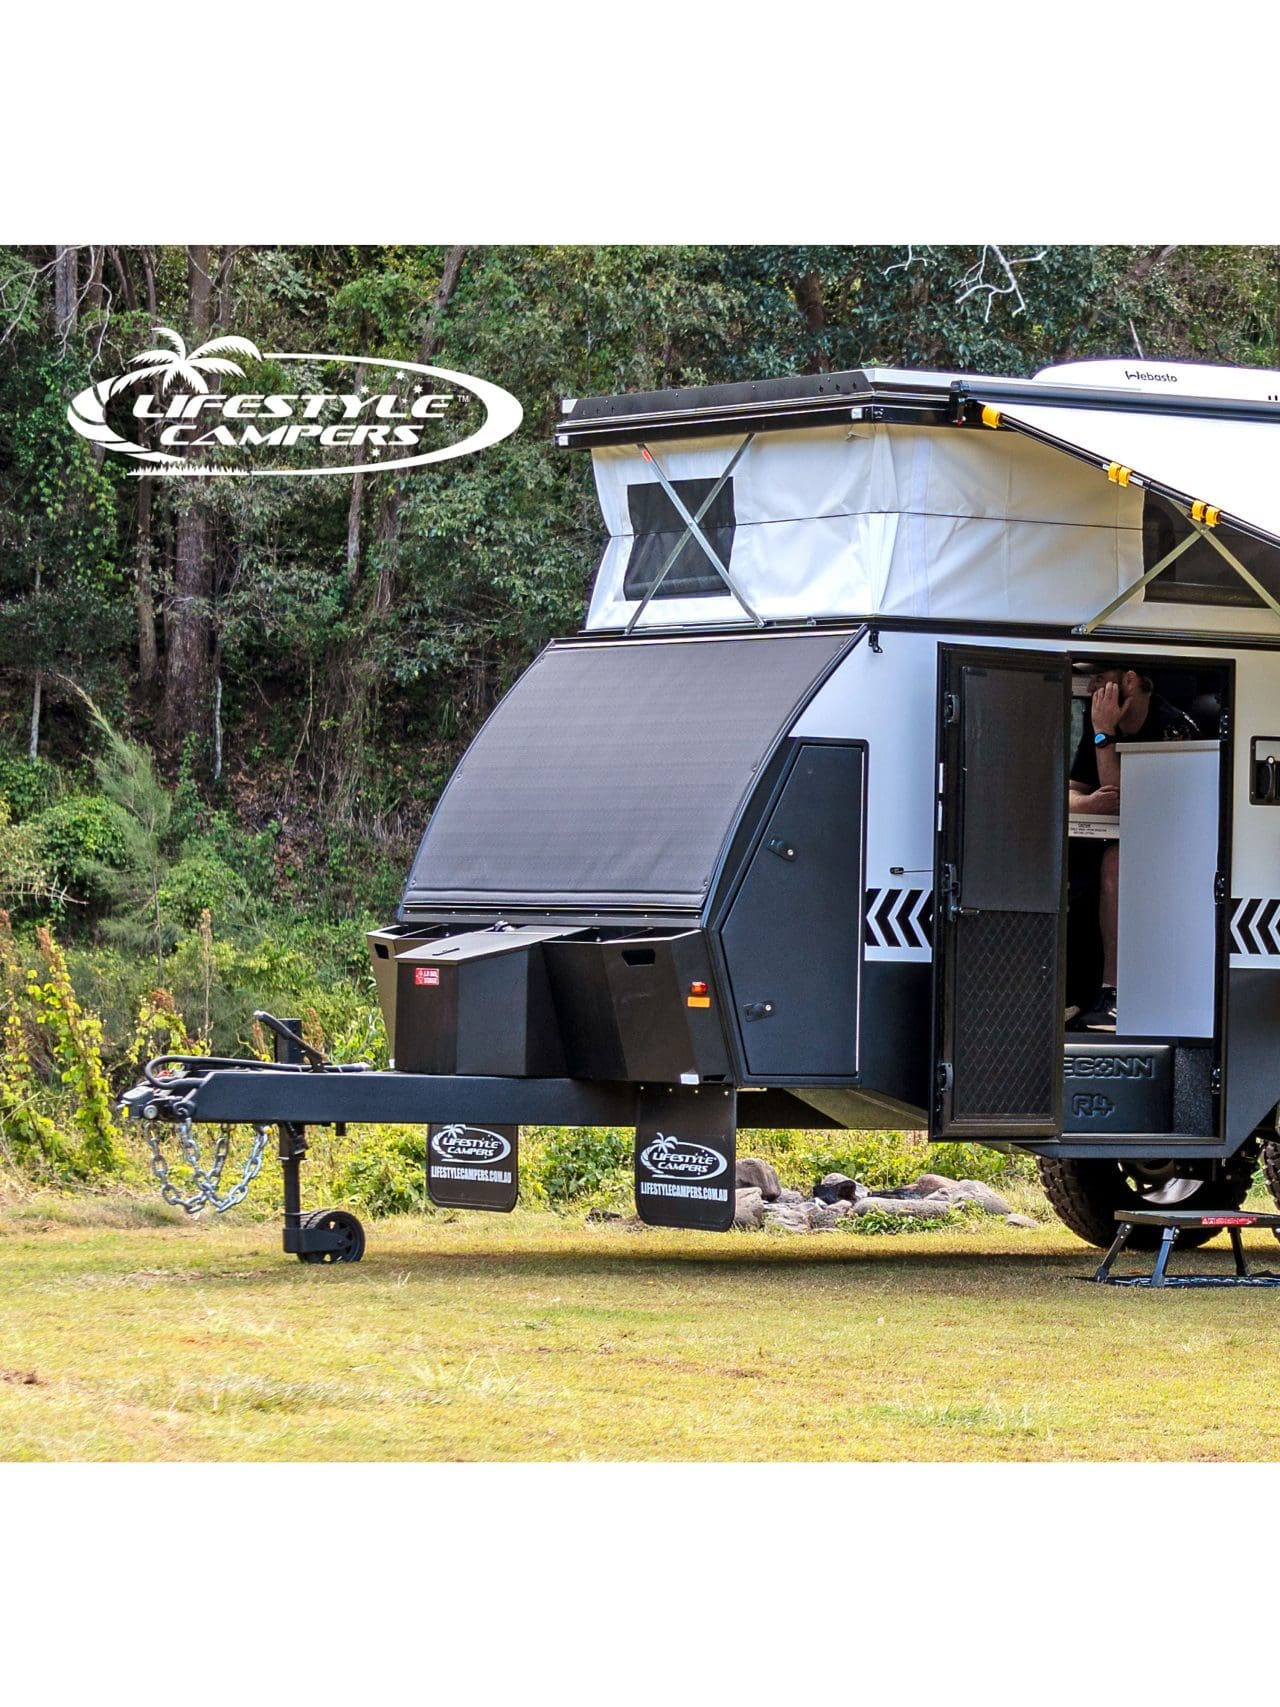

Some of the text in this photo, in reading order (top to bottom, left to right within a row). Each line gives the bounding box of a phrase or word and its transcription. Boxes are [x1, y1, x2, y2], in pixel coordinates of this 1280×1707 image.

[1125, 370, 1178, 383] Webasto
[1064, 1056, 1156, 1078] ECONN
[443, 1137, 499, 1149] LIFESTYLE
[447, 1146, 494, 1156] CAMPERS
[652, 1152, 714, 1165] LIFESTYLE
[657, 1162, 709, 1173] CAMPERS
[641, 1181, 728, 1202] LIFESTYLECAMPERS.COM.AU
